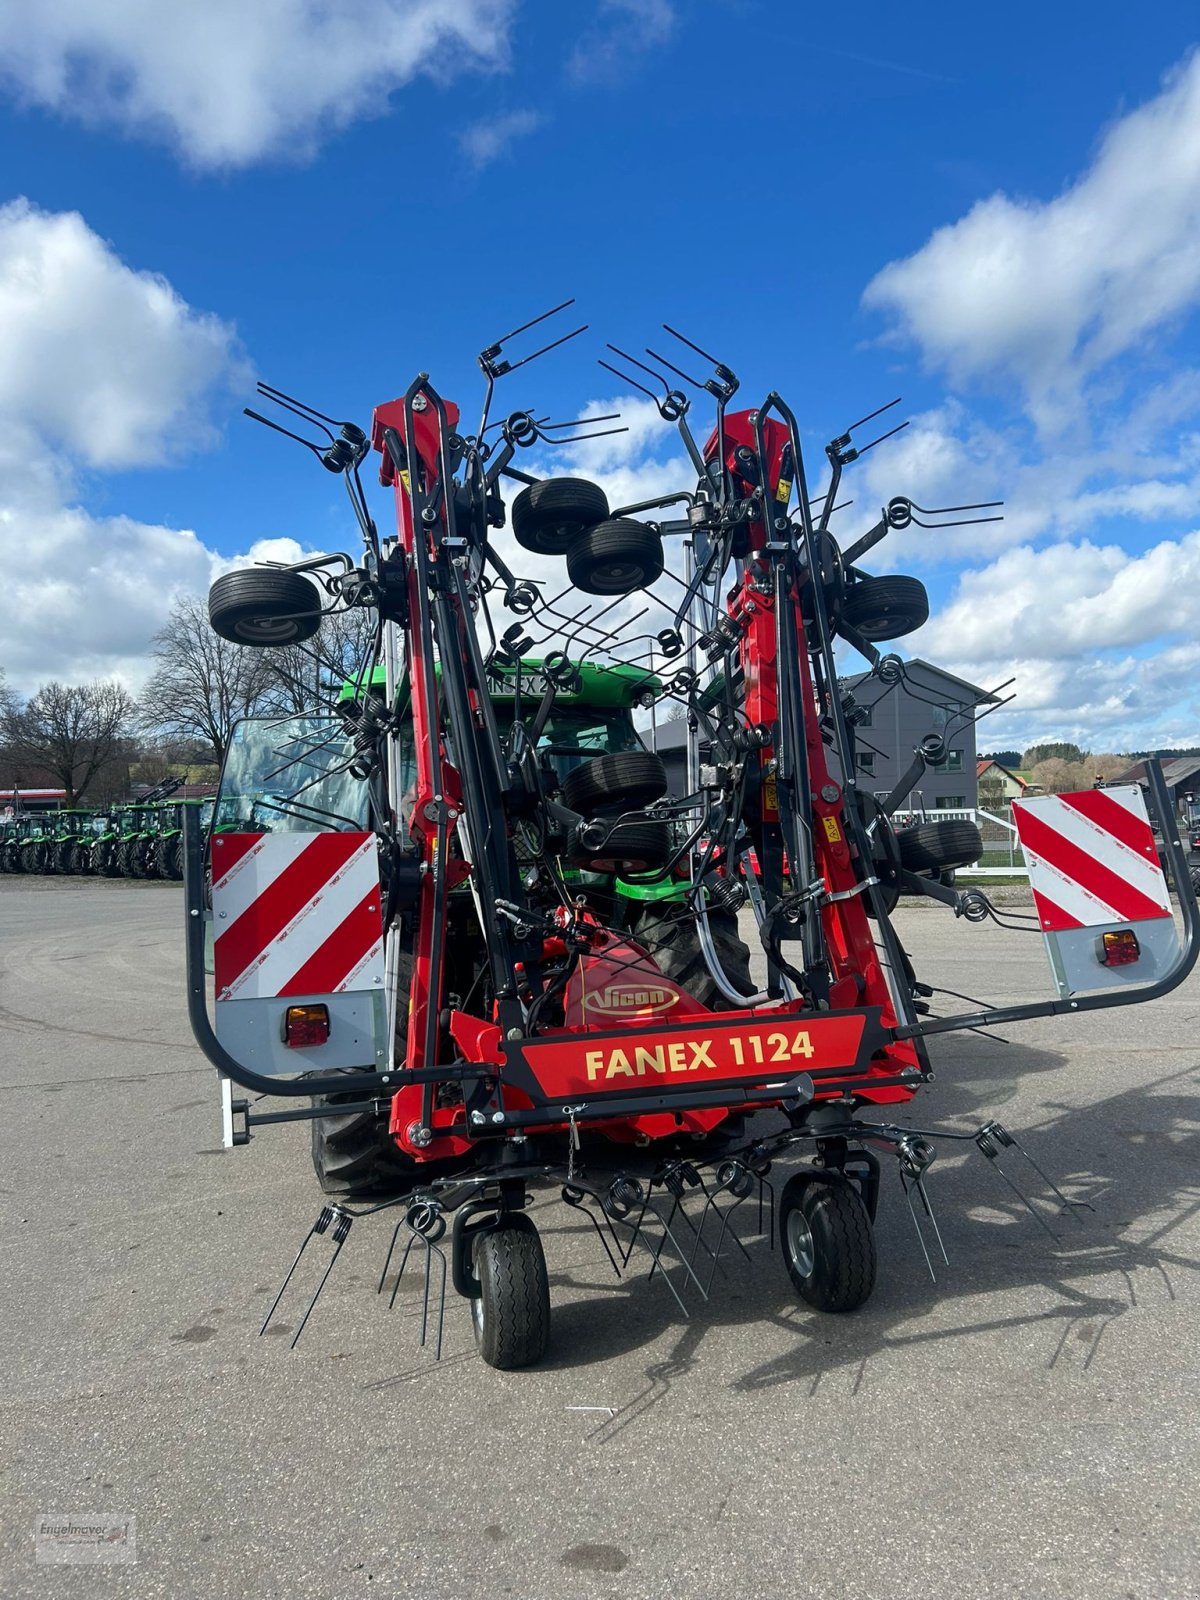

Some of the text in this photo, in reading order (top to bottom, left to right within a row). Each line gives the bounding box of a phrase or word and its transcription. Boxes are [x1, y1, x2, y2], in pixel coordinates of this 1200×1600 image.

[592, 986, 665, 1009] Vicon
[585, 1031, 815, 1080] FANEX 1124
